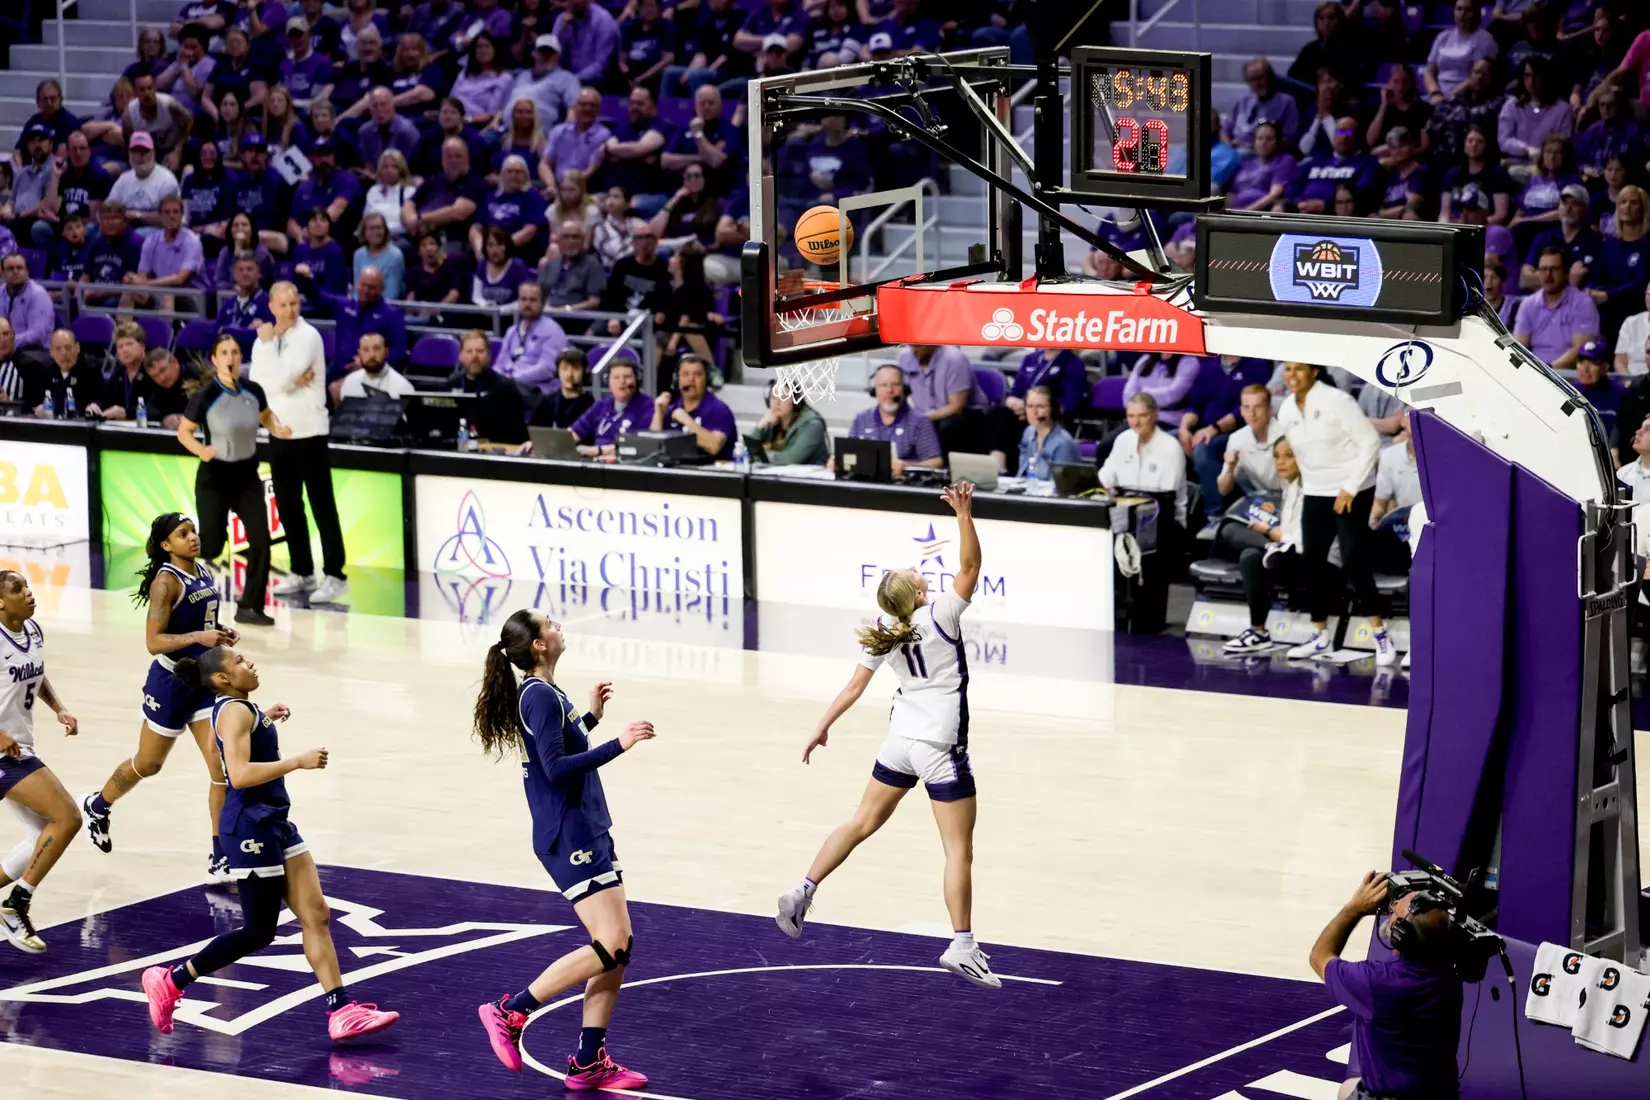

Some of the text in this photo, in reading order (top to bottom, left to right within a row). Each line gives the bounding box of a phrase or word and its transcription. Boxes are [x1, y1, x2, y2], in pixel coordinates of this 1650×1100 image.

[807, 238, 840, 251] Wilso
[1296, 261, 1358, 280] WBIT
[527, 493, 719, 542] Ascension
[528, 545, 730, 597] Via Christi
[861, 564, 1006, 597] FEDM
[204, 599, 218, 631] 5
[1588, 592, 1626, 617] SPALDING
[901, 643, 928, 678] 11
[24, 682, 36, 711] 5
[240, 838, 264, 855] GT
[570, 849, 593, 866] GT
